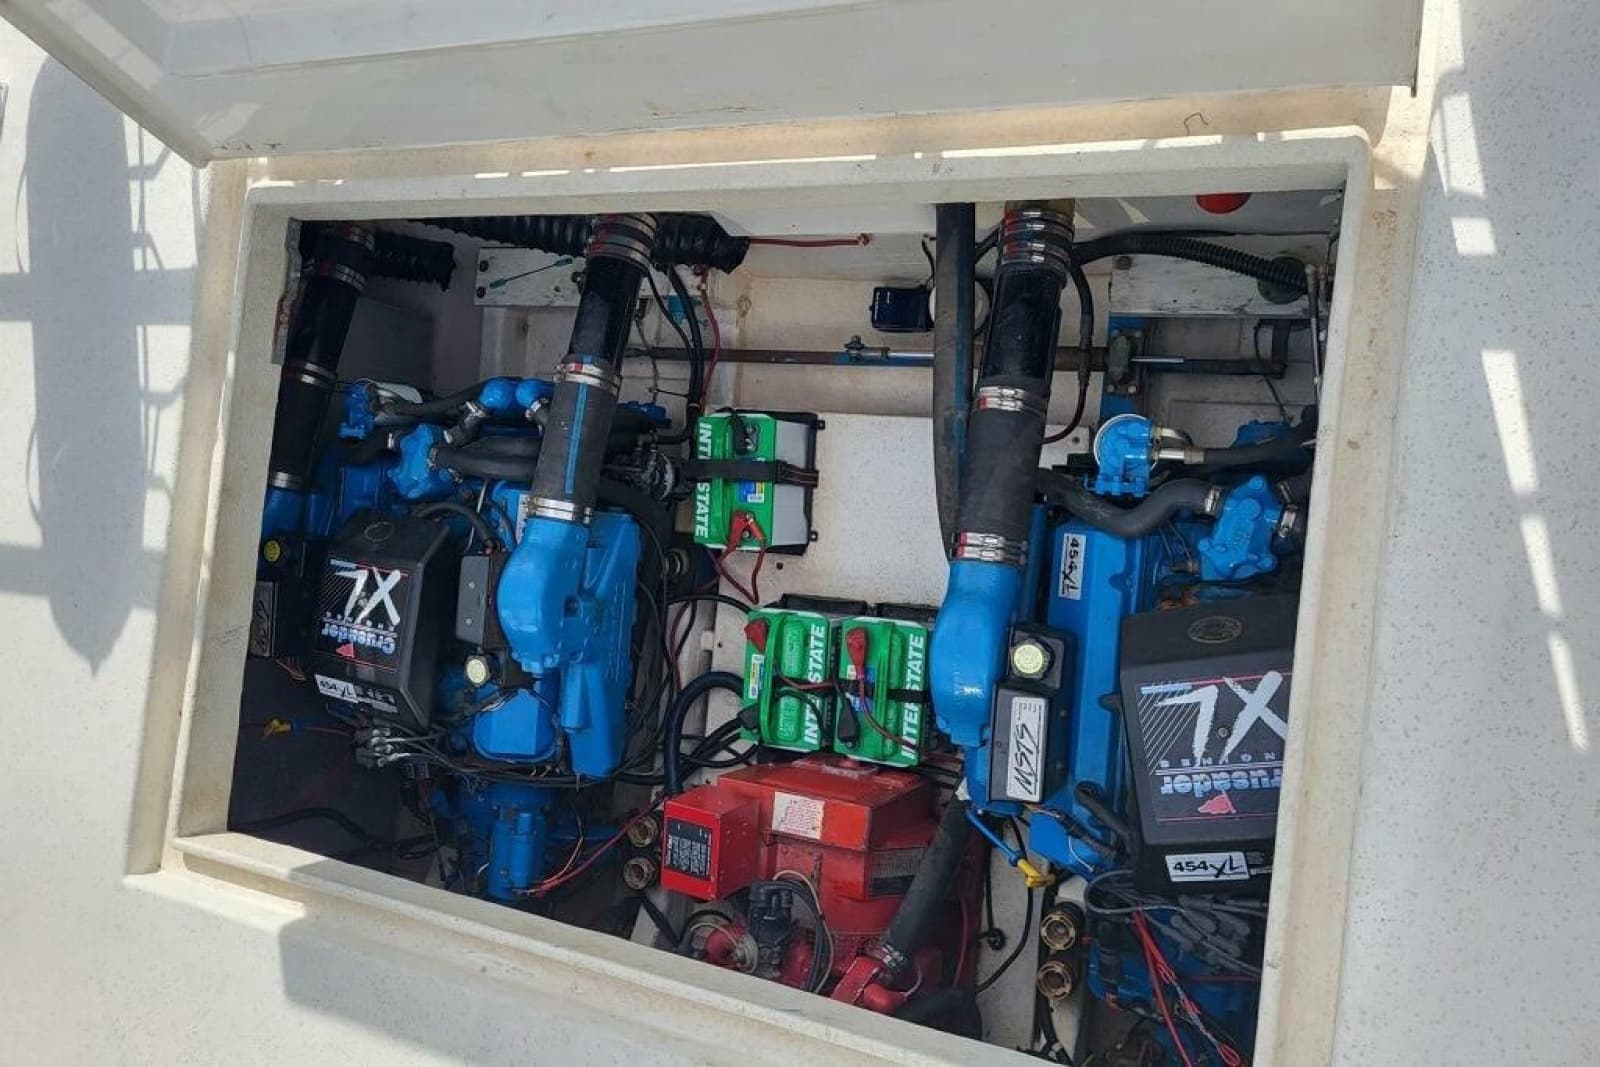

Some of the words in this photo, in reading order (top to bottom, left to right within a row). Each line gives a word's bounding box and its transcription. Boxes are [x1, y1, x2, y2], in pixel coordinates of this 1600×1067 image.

[695, 422, 712, 538] INTSTATE
[803, 623, 825, 745] INTSTATE
[1160, 769, 1282, 797] rusader
[1173, 855, 1244, 878] 454XL
